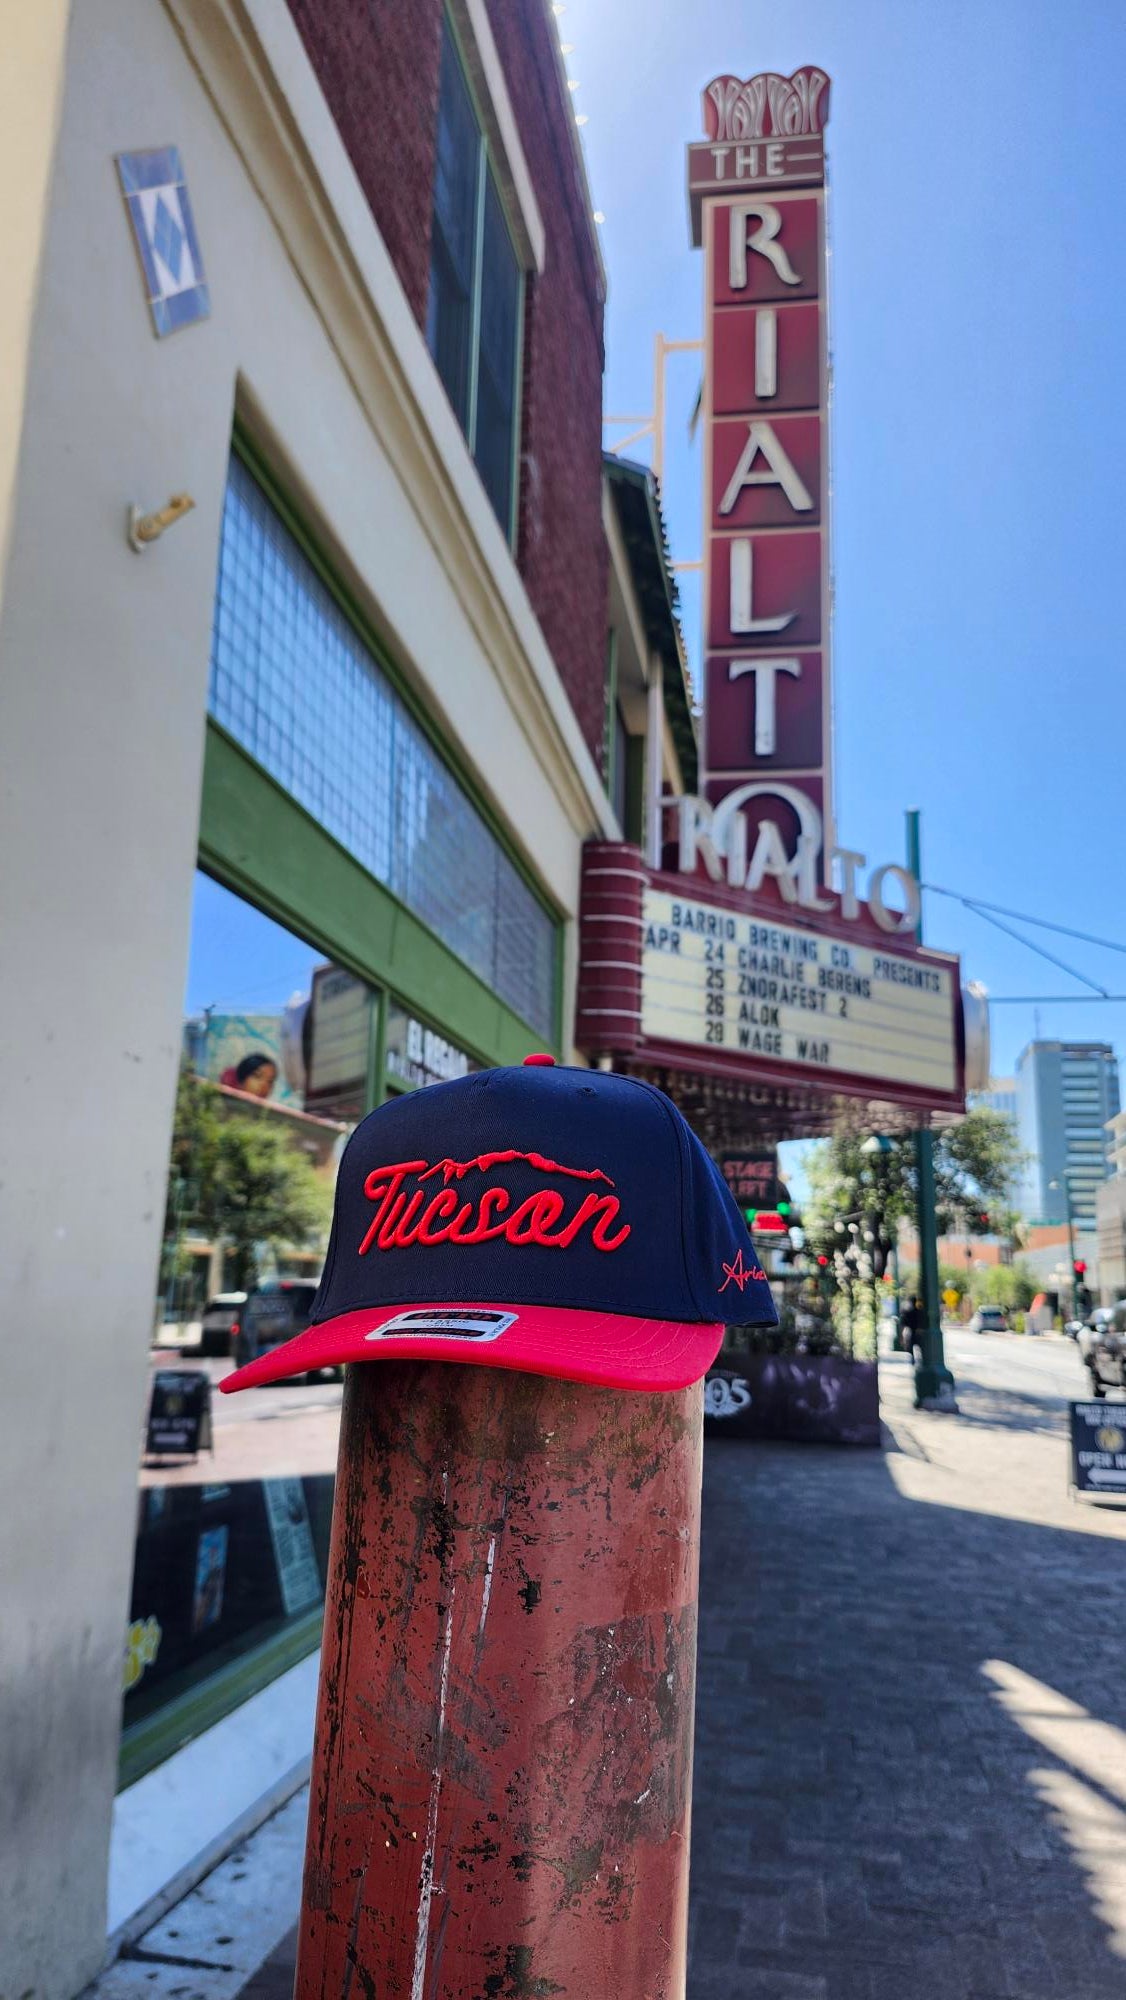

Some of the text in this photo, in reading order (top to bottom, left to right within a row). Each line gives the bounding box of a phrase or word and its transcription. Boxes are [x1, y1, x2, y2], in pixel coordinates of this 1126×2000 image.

[711, 144, 785, 179] THE
[712, 203, 823, 876] RIALTO
[677, 795, 921, 934] RIALTO
[645, 924, 871, 999] APR 24 CHARLIE BERENS
[671, 903, 736, 940] BARRIO
[749, 924, 818, 962] BREWING
[873, 957, 940, 993] PRESENTS
[706, 967, 847, 1018] 25 ZNORAFEST 2
[739, 1001, 779, 1027] ALOK
[738, 1027, 782, 1056] WAGE
[797, 1039, 829, 1063] WAR
[358, 1160, 631, 1255] Tucson
